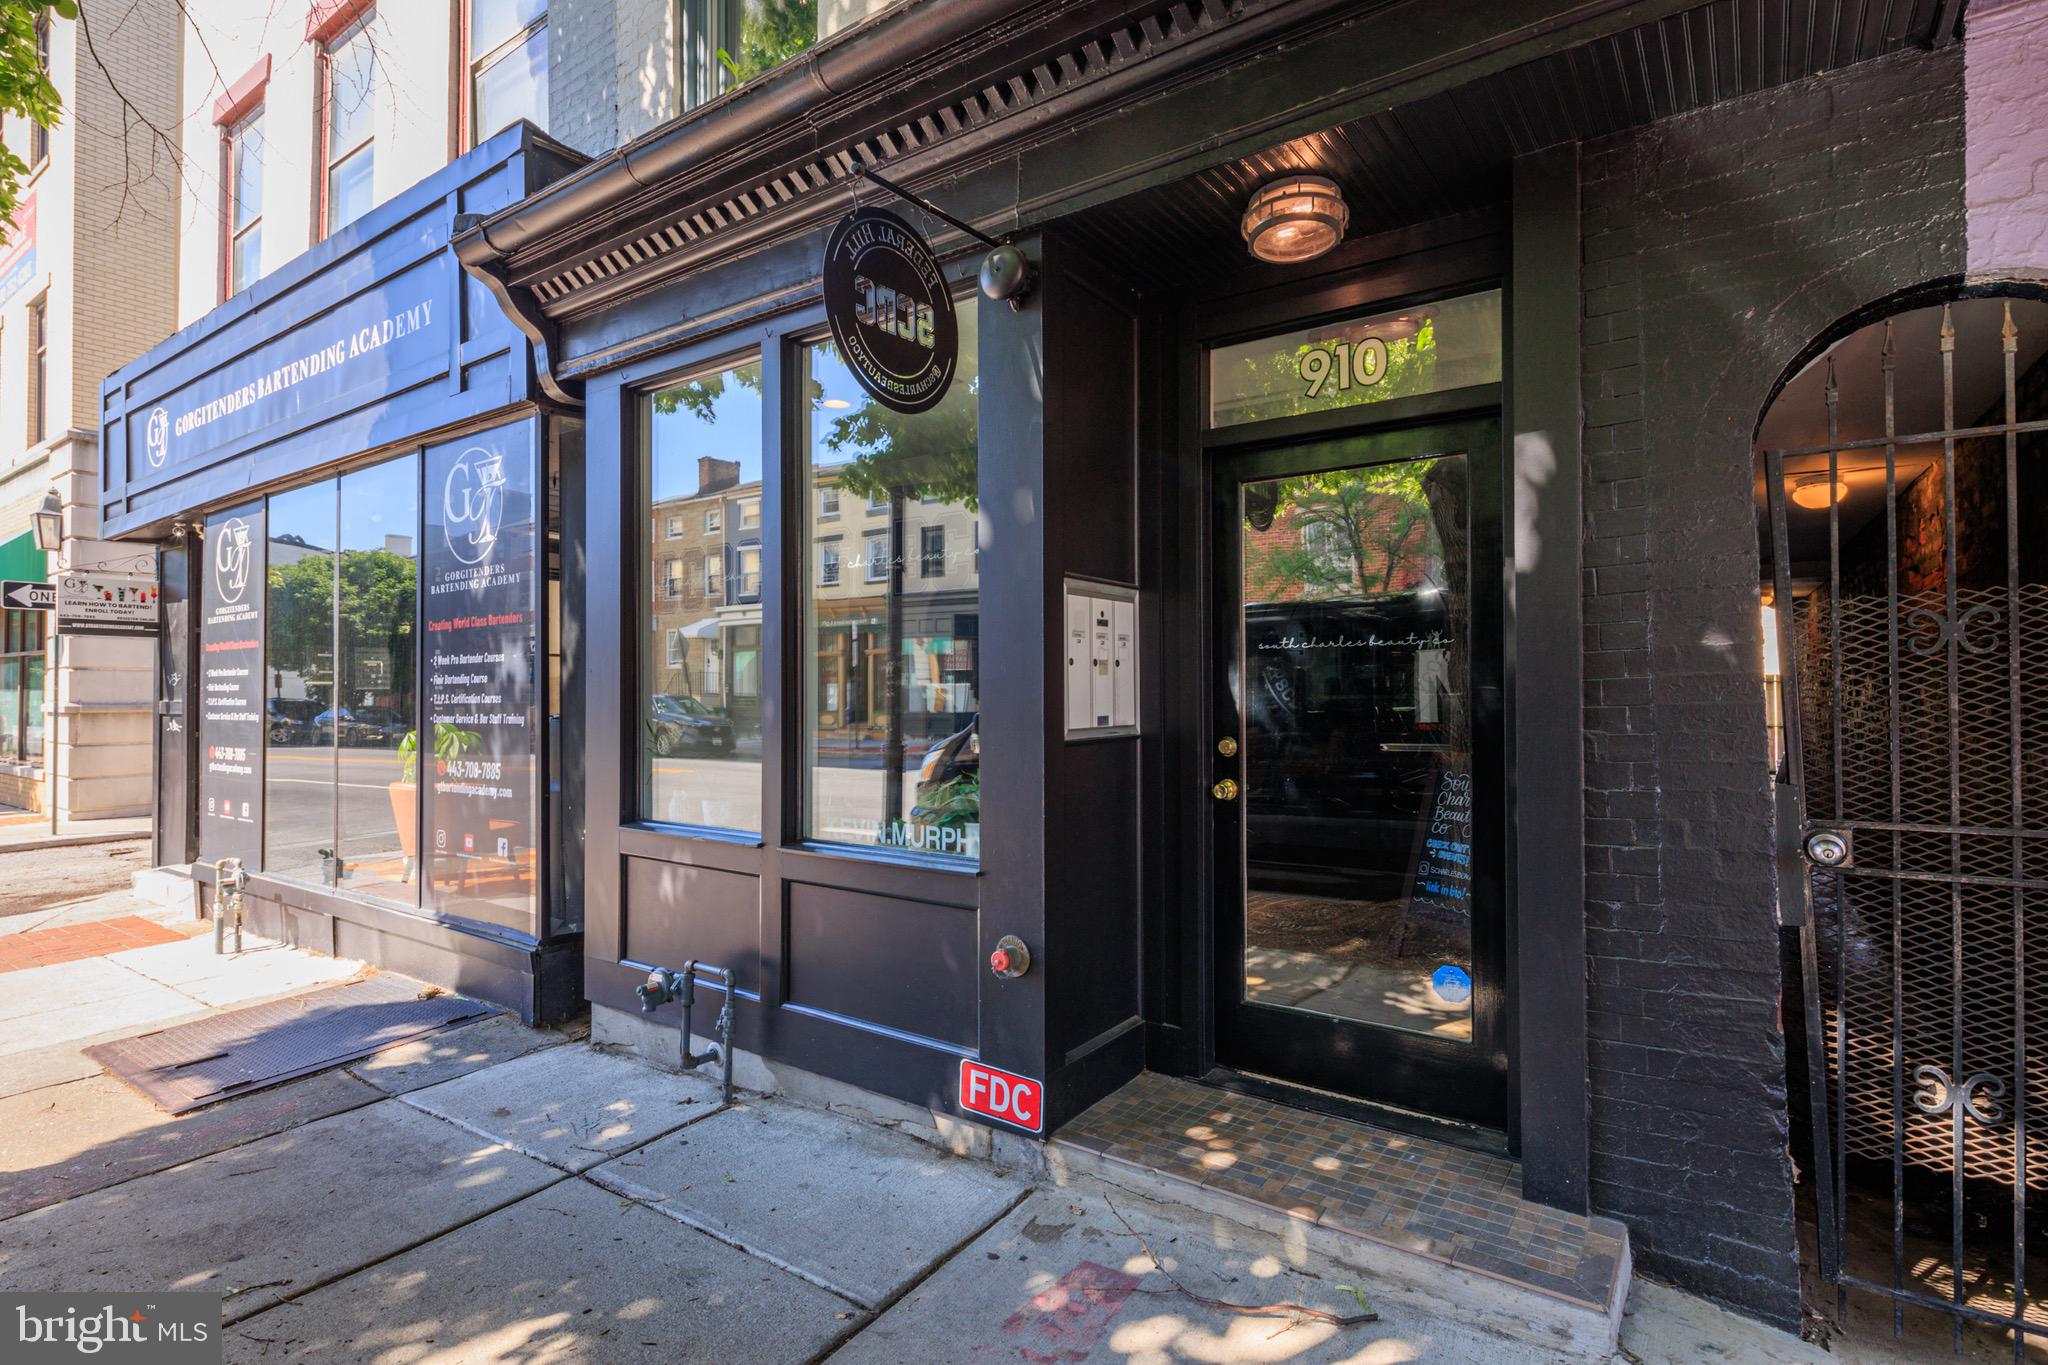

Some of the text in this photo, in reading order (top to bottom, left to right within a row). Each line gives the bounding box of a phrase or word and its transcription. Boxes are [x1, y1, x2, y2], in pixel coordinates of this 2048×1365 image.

[175, 299, 434, 436] GORGITENDERS BARTENDING ACADEMY
[1300, 337, 1388, 398] 910
[444, 563, 505, 582] GORGITENDERS
[431, 572, 521, 595] BARTENDING ACADEMY
[236, 611, 258, 622] ACADEMY
[428, 612, 523, 633] Creating World Class Bartenders
[1258, 636, 1301, 650] south
[1302, 634, 1368, 649] charles
[1368, 632, 1429, 650] beauty
[433, 652, 505, 666] 2 Week Pro Bartender Courses
[433, 673, 488, 686] Flair Bartending Course
[451, 693, 480, 704] Certification
[481, 693, 502, 704] Courses
[433, 713, 525, 727] Customer Service & Bar Staff Training
[446, 760, 501, 780] 443-708-7885
[1441, 771, 1471, 792] Sou
[1437, 791, 1472, 806] Char
[1434, 806, 1472, 822] Beaut
[1441, 885, 1449, 895] in
[969, 1069, 1032, 1121] FDC
